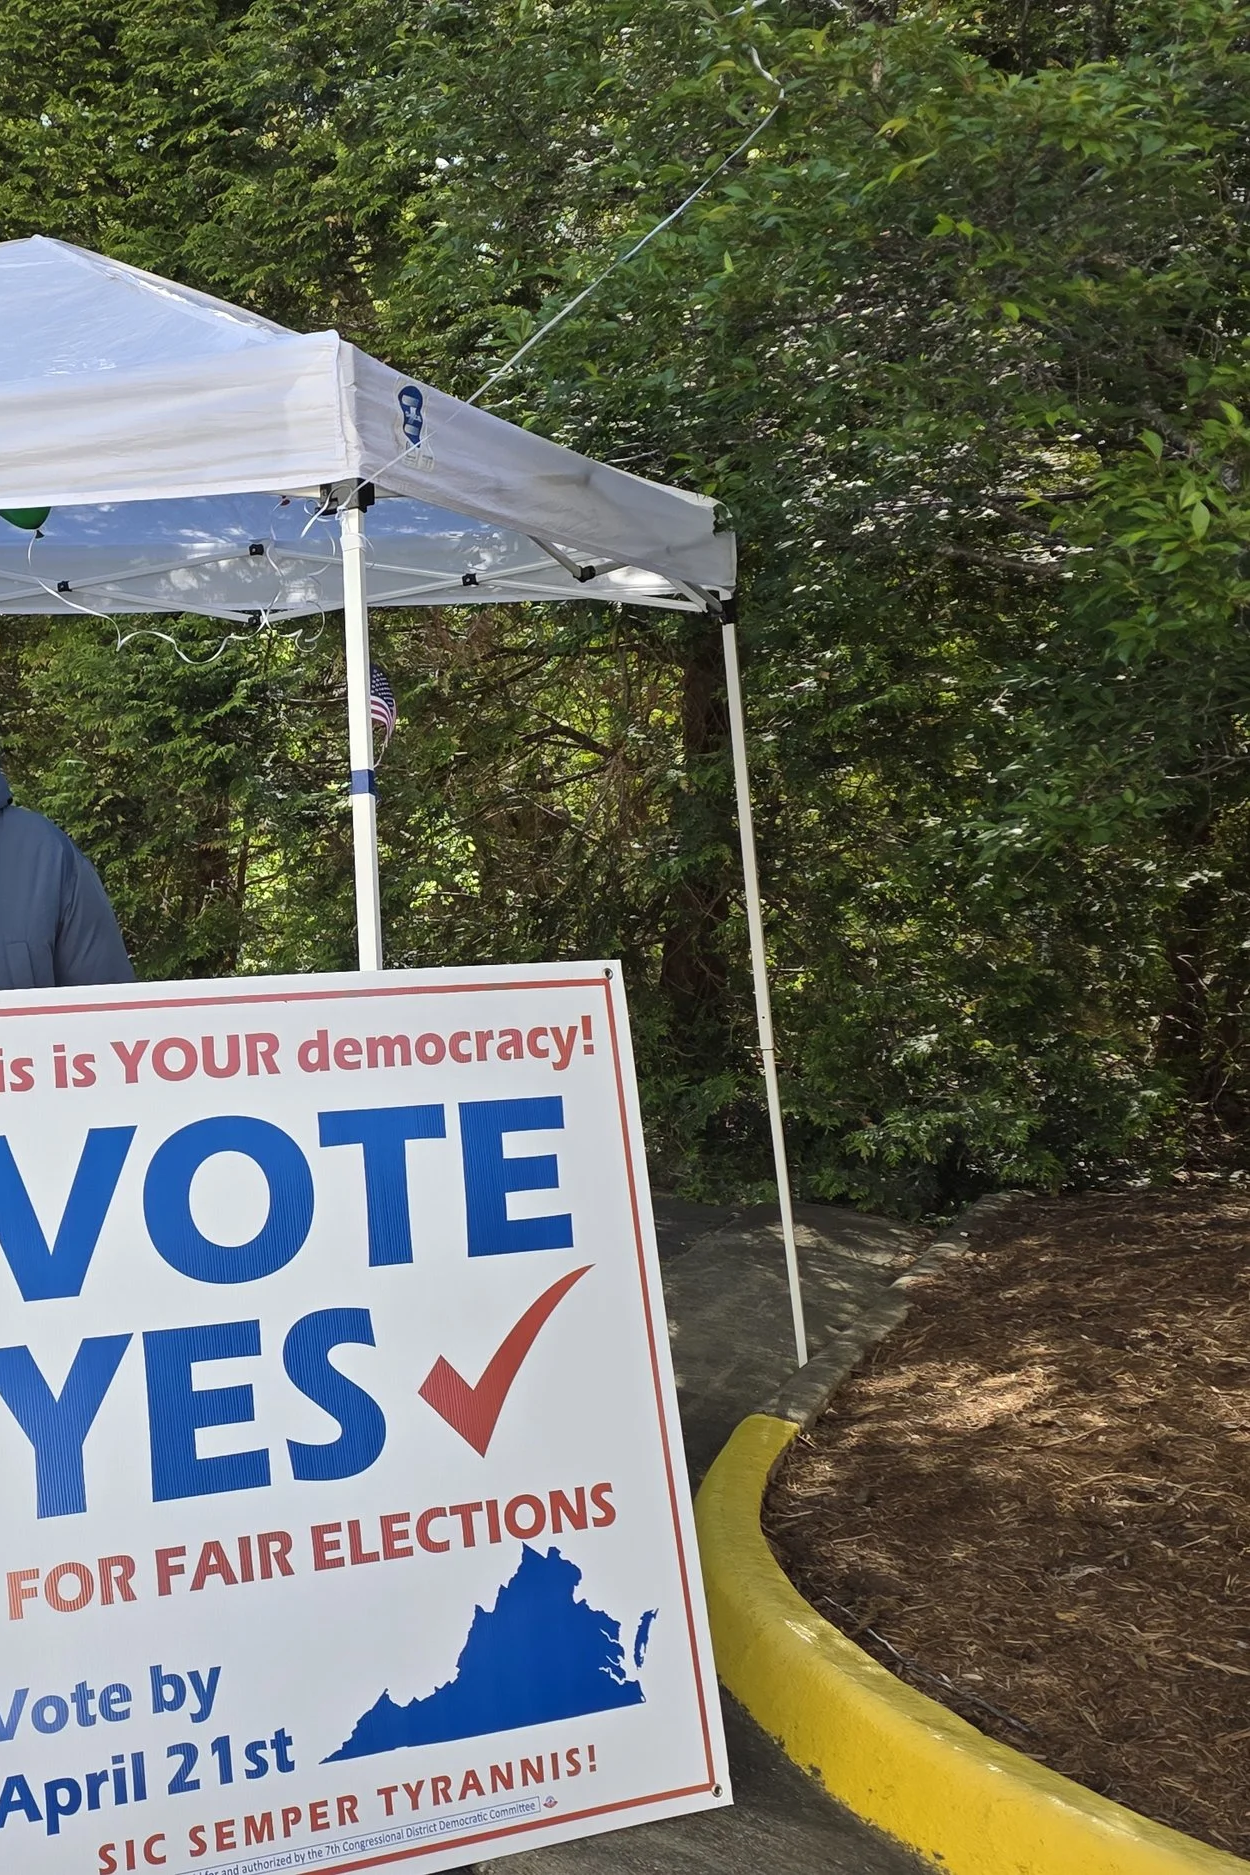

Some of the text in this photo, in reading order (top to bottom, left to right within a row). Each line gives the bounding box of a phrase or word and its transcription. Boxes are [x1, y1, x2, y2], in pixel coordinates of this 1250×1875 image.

[53, 1043, 96, 1089] is
[111, 1032, 281, 1084] YOUR
[297, 1015, 596, 1075] democracy!
[6, 1482, 616, 1620] FOR FAIR ELECTIONS
[150, 1664, 222, 1724] by
[166, 1727, 296, 1795] 21st
[97, 1745, 598, 1875] SIC SEMPER TYRANNIS!
[221, 1864, 239, 1875] and
[241, 1853, 292, 1874] authorized
[294, 1851, 306, 1864] by
[307, 1848, 323, 1860] the
[325, 1844, 340, 1856] 7th
[342, 1829, 404, 1851] Congressional
[406, 1821, 437, 1839] District
[439, 1812, 488, 1831] Democratic
[489, 1802, 536, 1820] Committee
